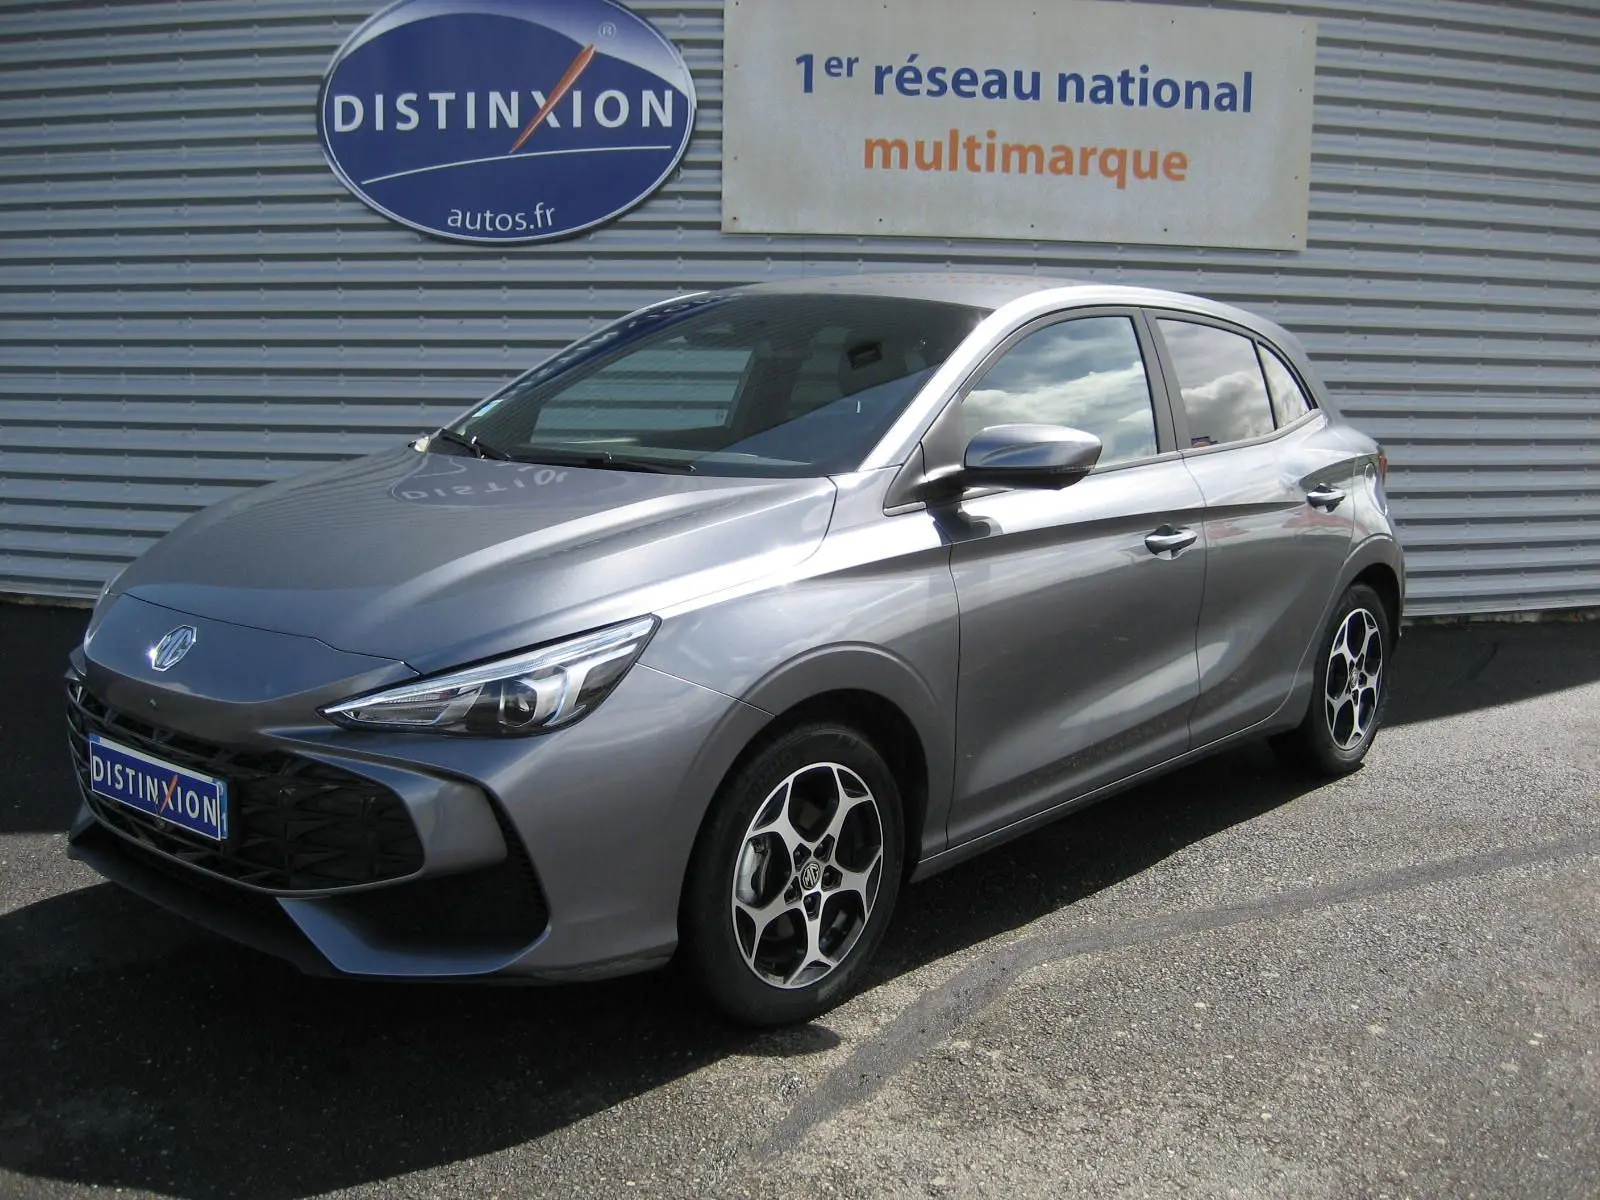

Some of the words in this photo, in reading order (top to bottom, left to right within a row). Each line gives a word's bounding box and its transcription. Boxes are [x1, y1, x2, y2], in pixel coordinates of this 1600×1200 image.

[795, 53, 859, 94] 1er
[873, 54, 1041, 101] réseau
[1057, 65, 1253, 113] national
[334, 87, 673, 134] DISTINXION
[864, 129, 1189, 189] multimarque
[447, 202, 556, 231] autos.fr
[92, 755, 217, 827] DISTINXION
[802, 862, 821, 889] MG
